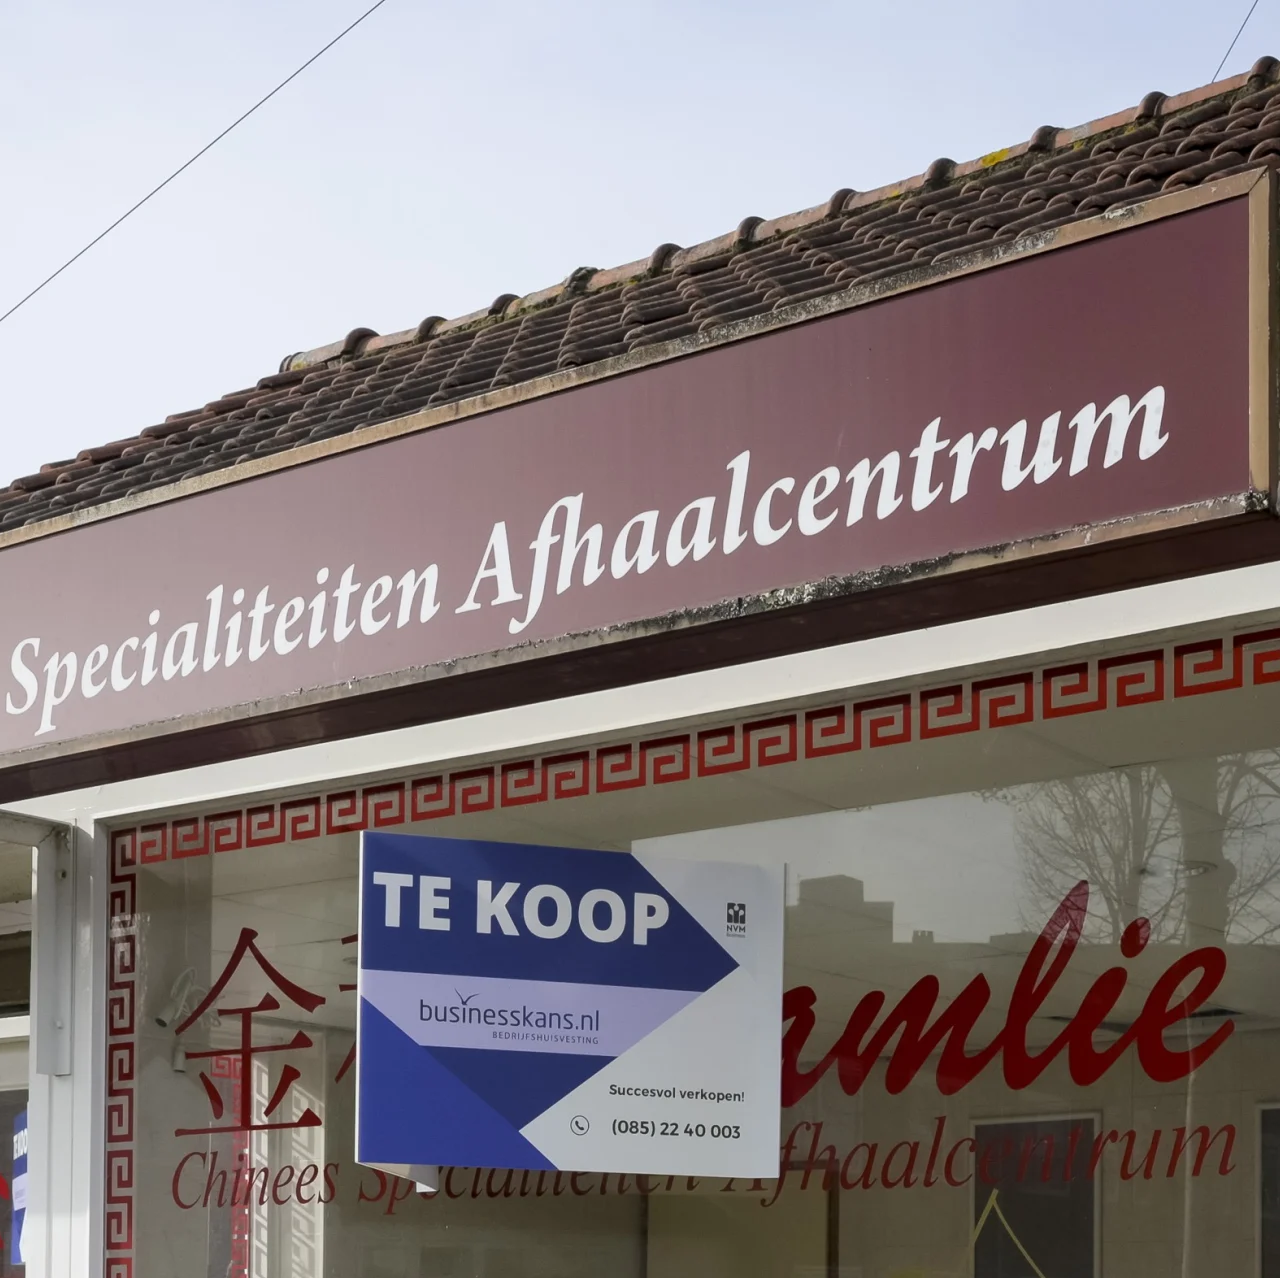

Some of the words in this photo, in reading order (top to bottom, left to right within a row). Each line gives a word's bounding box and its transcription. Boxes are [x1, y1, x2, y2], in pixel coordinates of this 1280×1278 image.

[5, 563, 441, 735] Specialiteiten
[455, 385, 1170, 634] Afhaalcentrum
[372, 870, 451, 931] TE
[476, 879, 670, 946] KOOP
[726, 924, 746, 933] NVM
[419, 998, 600, 1031] businesskans.nl
[492, 1030, 599, 1044] BEDRIJFSHUISVESTING
[609, 1084, 675, 1099] Succesvol
[679, 1088, 745, 1103] verkopen!
[612, 1119, 656, 1137] (085)
[660, 1121, 680, 1137] 22
[683, 1122, 707, 1138] 40
[710, 1123, 741, 1139] 003
[172, 1149, 340, 1210] Chinees
[721, 1115, 1236, 1208] fhaalcentrum
